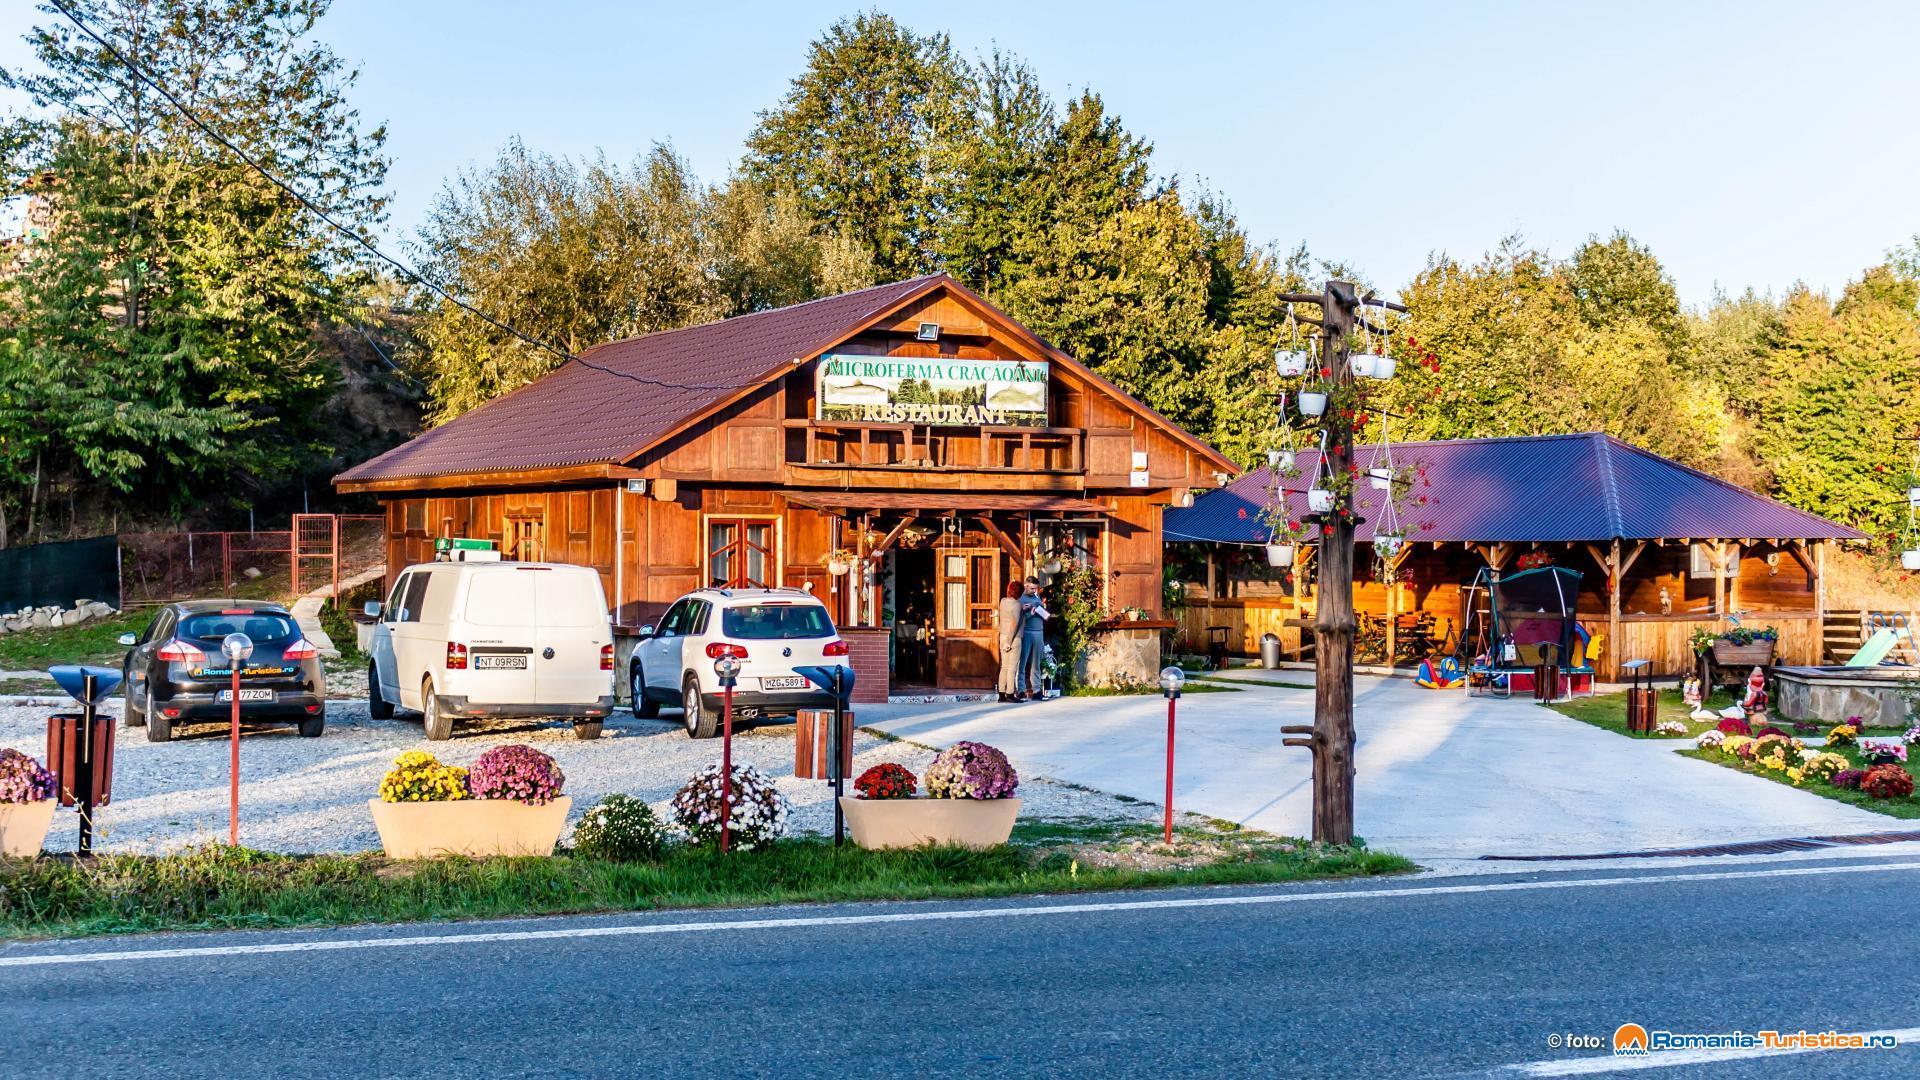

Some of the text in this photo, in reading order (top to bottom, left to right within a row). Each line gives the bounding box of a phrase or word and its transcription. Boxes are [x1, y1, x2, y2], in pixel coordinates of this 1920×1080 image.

[829, 361, 943, 379] MICROFERMA
[862, 403, 1007, 424] RESTAURANT
[203, 667, 294, 676] Roman-Turistica.ro
